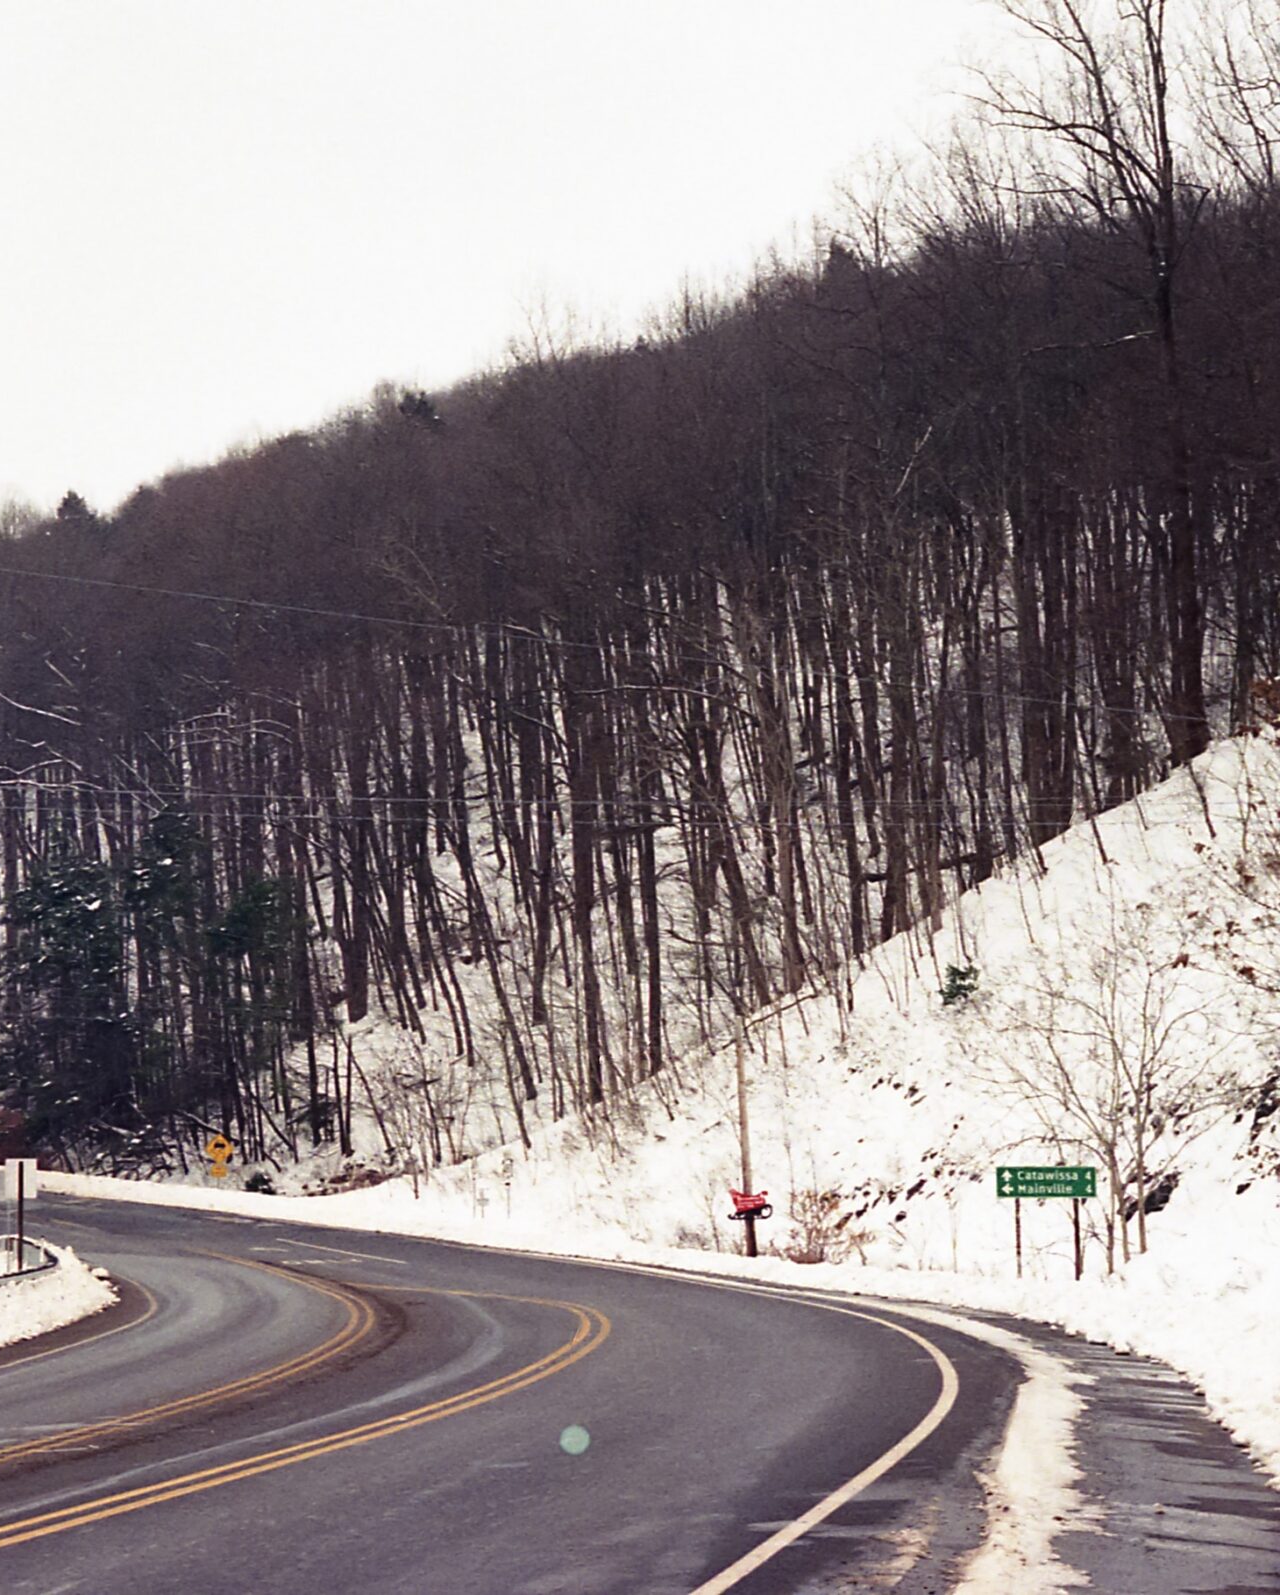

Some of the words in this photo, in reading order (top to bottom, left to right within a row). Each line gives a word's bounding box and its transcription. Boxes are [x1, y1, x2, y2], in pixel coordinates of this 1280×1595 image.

[1017, 1170, 1079, 1181] Catawissa
[1085, 1171, 1092, 1180] 4
[1018, 1183, 1073, 1194] Mainville
[1085, 1184, 1093, 1193] 4
